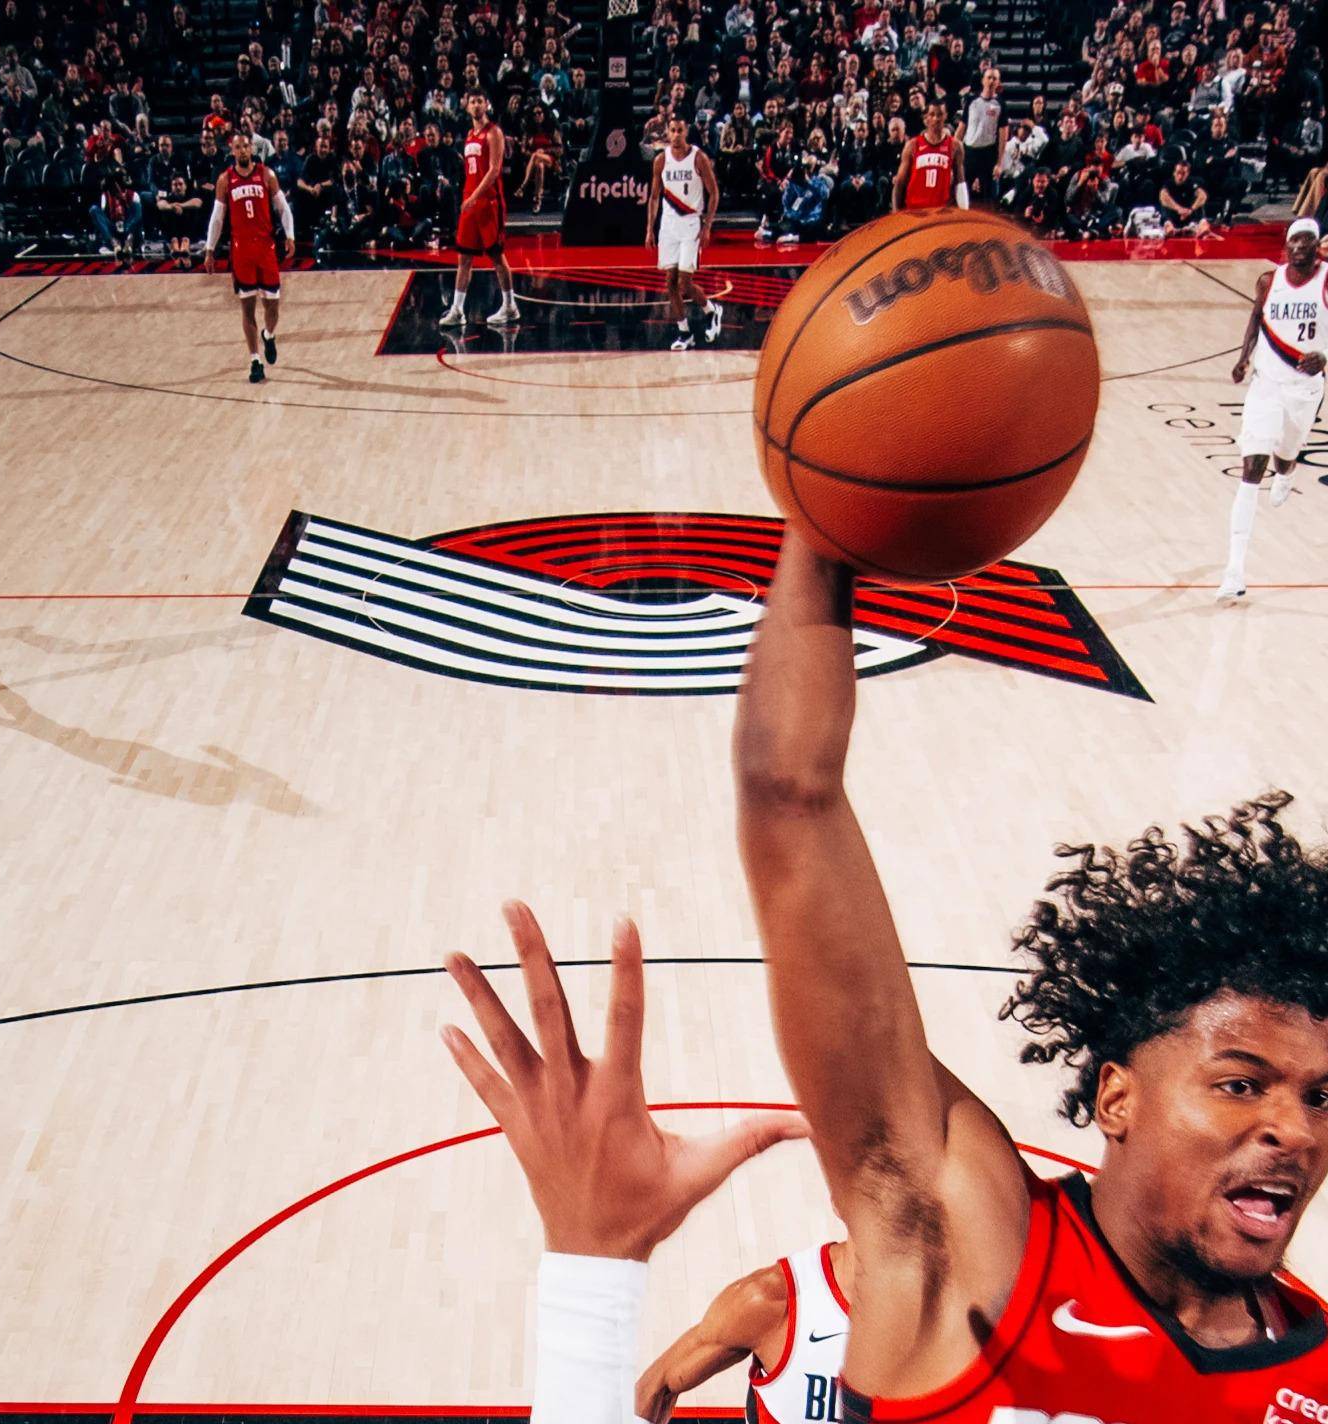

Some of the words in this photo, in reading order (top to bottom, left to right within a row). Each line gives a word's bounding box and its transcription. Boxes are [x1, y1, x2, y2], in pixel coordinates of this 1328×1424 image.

[925, 168, 937, 188] 10
[580, 175, 649, 205] ripcity
[245, 200, 254, 219] 9
[1270, 302, 1318, 321] BLAZERS
[1297, 321, 1317, 342] 26
